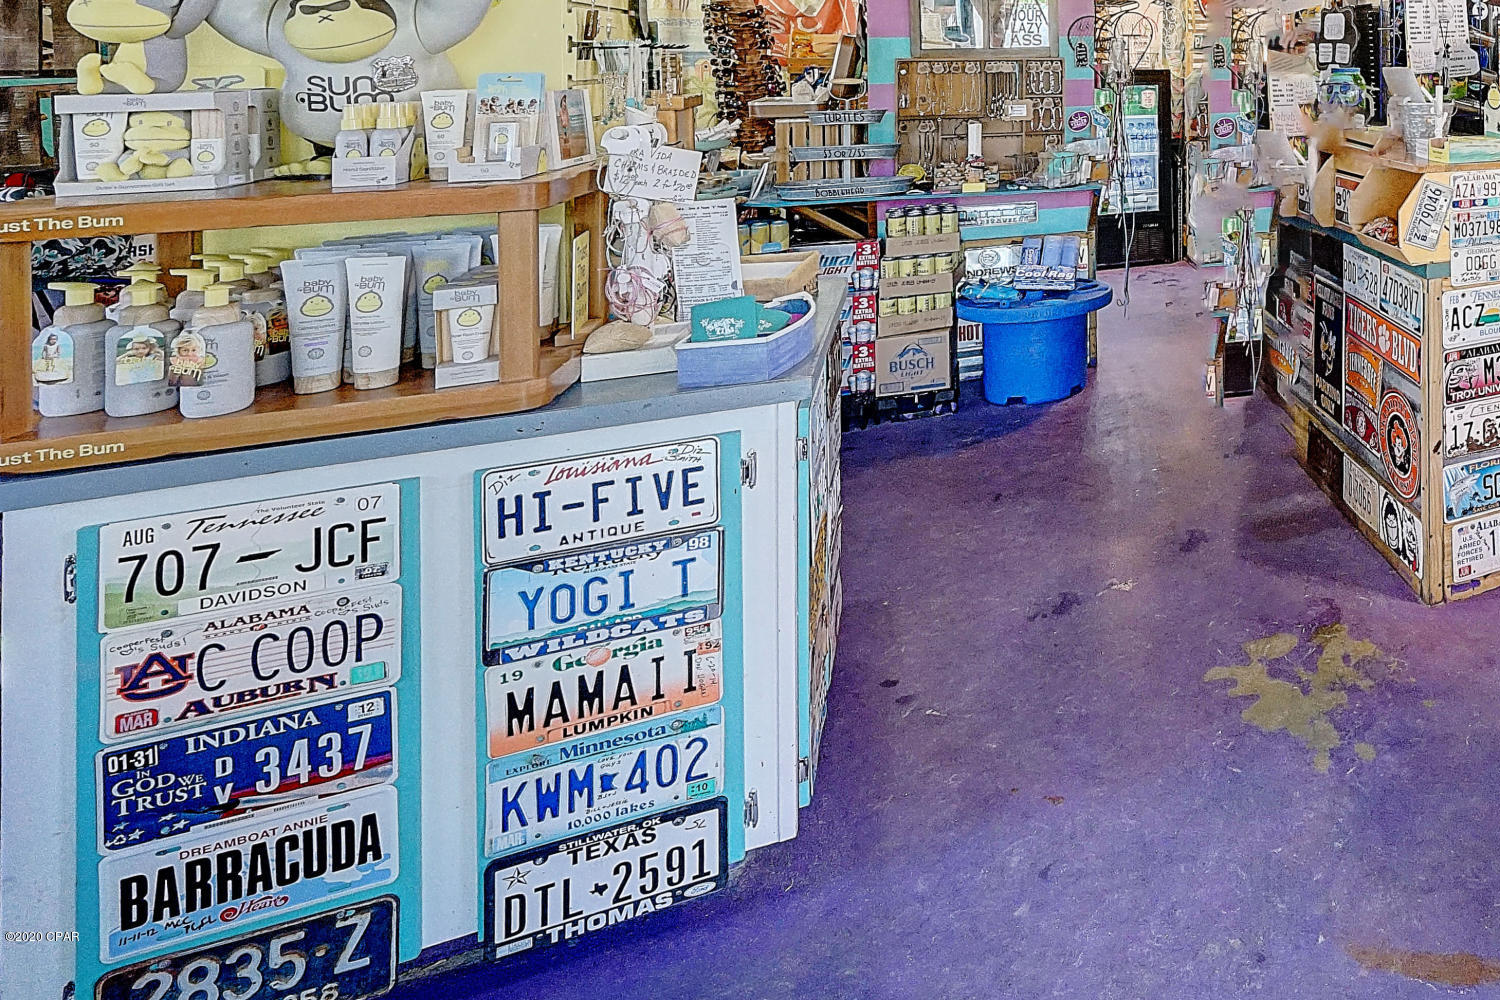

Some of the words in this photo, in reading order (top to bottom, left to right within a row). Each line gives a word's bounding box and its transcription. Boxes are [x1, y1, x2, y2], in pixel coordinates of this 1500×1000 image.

[1011, 34, 1042, 46] ASS
[824, 113, 864, 122] TURTLES
[1456, 184, 1475, 198] AZA
[1419, 188, 1442, 227] 79046
[0, 222, 30, 233] ust
[34, 219, 73, 231] The
[78, 216, 124, 228] Bum
[862, 244, 871, 255] 3
[303, 279, 331, 287] baby
[1015, 269, 1044, 279] Cool
[1045, 269, 1076, 280] Rag
[1450, 295, 1460, 304] FEB
[959, 324, 981, 341] HOT
[1451, 303, 1485, 332] ACZ
[1348, 305, 1377, 345] TIGERS
[1392, 331, 1416, 373] BLVD
[889, 357, 935, 374] BUSCH
[1450, 389, 1477, 401] TROY
[0, 455, 32, 467] ust
[35, 448, 75, 462] The
[79, 442, 125, 456] Bum
[544, 453, 664, 485] Louisiana
[497, 466, 705, 539] HI-FIVE
[123, 527, 154, 548] AUG
[185, 506, 325, 541] Tennessee
[356, 495, 382, 512] 07
[559, 521, 645, 546] ANTIQUE
[117, 543, 221, 604] 707
[295, 517, 387, 573] JCF
[547, 539, 666, 571] KENTUCKY
[688, 536, 709, 550] 98
[1457, 554, 1484, 566] RETIRED
[200, 580, 307, 610] DAVIDSON
[518, 570, 635, 631] YOGI
[672, 557, 696, 598] T
[203, 604, 311, 633] ALABAMA
[502, 609, 705, 663] WILDCATS
[196, 643, 227, 692] C
[251, 613, 383, 682] COOP
[552, 635, 664, 673] Georgia
[175, 673, 338, 721] AUBURN
[119, 713, 154, 733] MAR
[185, 711, 320, 756] INDIANA
[358, 701, 375, 714] 12
[563, 706, 654, 738] LUMPKIN
[107, 747, 156, 773] 01-31
[215, 757, 233, 778] D
[254, 723, 372, 794] 3437
[506, 758, 552, 776] EXPLORE
[560, 725, 666, 761] Minnesota
[111, 772, 174, 797] GOD
[178, 773, 205, 786] WE
[136, 769, 151, 780] IN
[501, 763, 594, 834] KWM
[624, 736, 709, 794] 402
[111, 784, 207, 817] TRUST
[567, 811, 611, 830] 10,000
[616, 799, 655, 817] lakes
[178, 826, 280, 861] DREAMBOAT
[282, 814, 329, 835] ANNIE
[558, 825, 640, 851] STILLWATER,
[642, 816, 662, 827] OK
[566, 828, 657, 865] TEXAS
[119, 812, 383, 932] BARRACUDA
[504, 878, 584, 939] DTL
[612, 839, 711, 905] 2591
[545, 893, 674, 944] THOMAS
